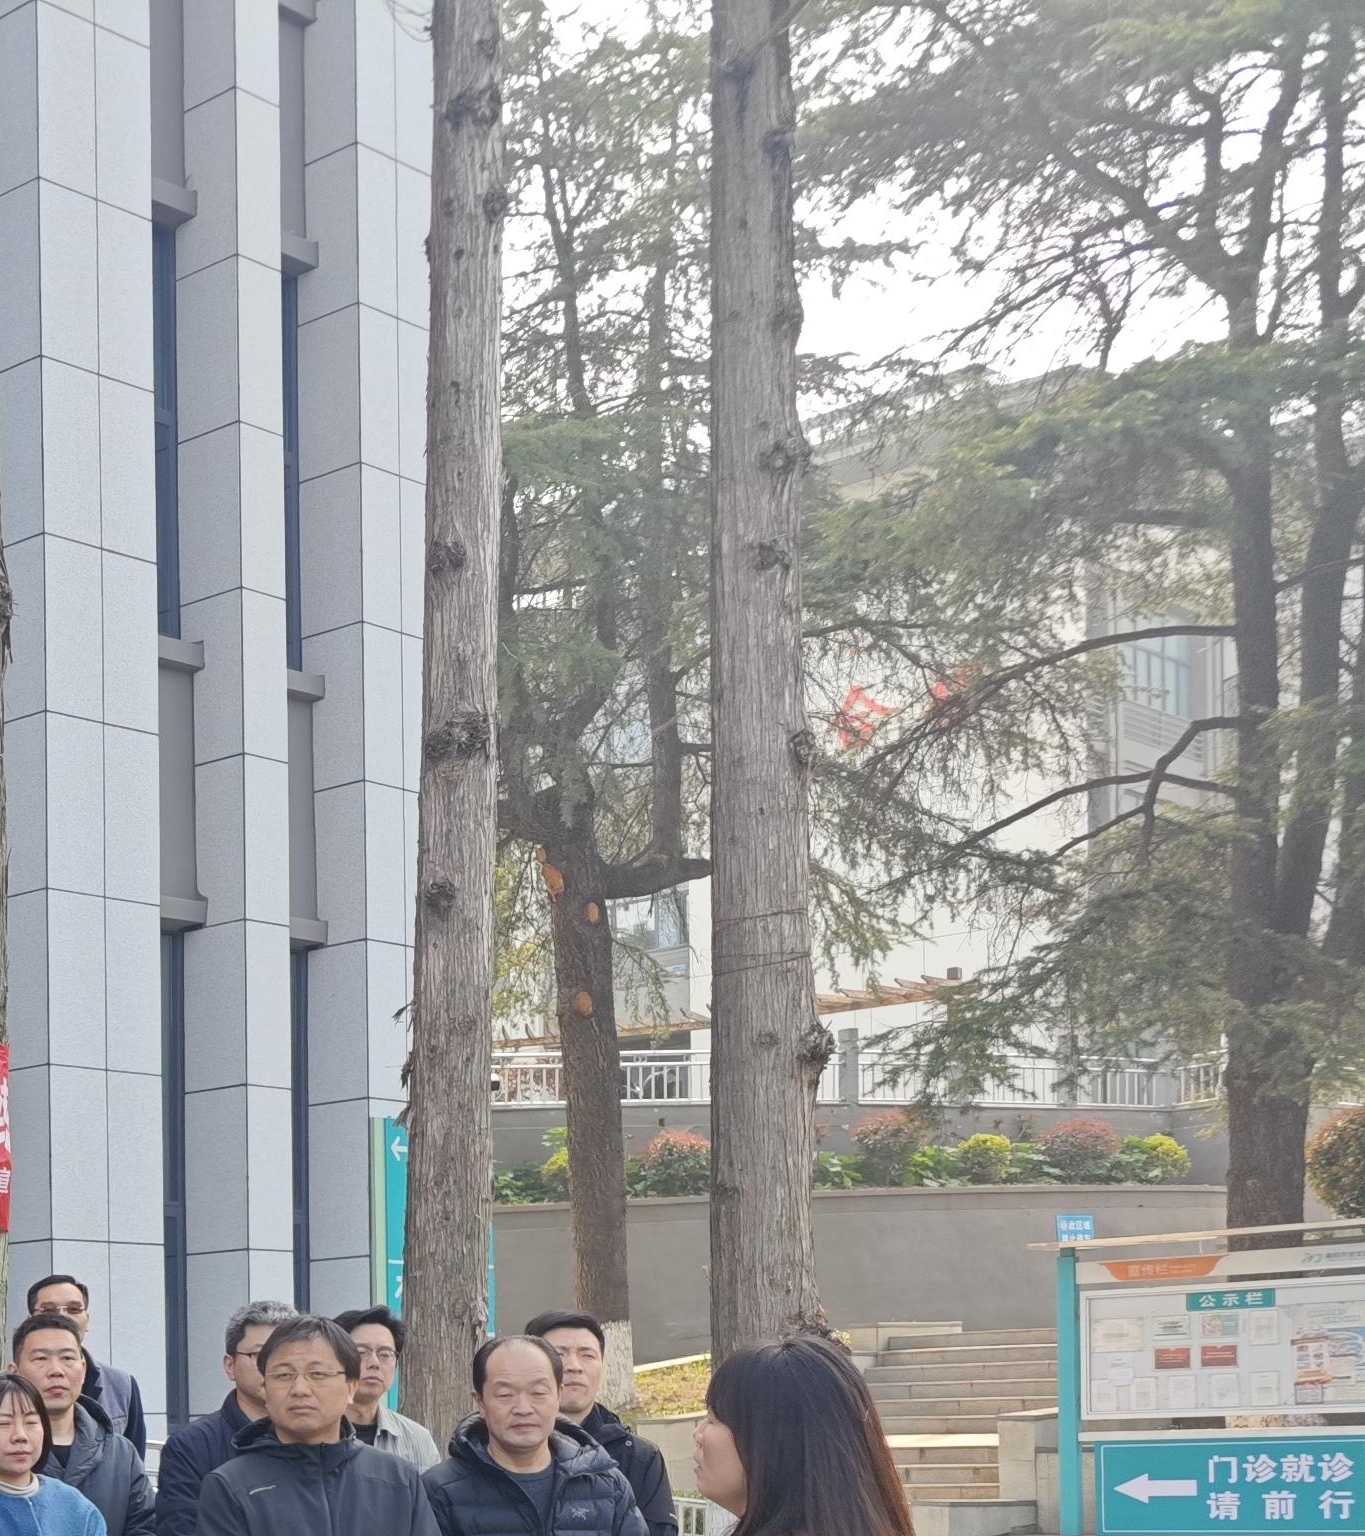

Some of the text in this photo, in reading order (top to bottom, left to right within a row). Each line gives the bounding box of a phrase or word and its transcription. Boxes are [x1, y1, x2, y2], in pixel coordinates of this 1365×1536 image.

[1198, 1291, 1264, 1307] 公示栏
[1207, 1452, 1356, 1485] 门诊就诊
[1206, 1490, 1356, 1521] 请前行
